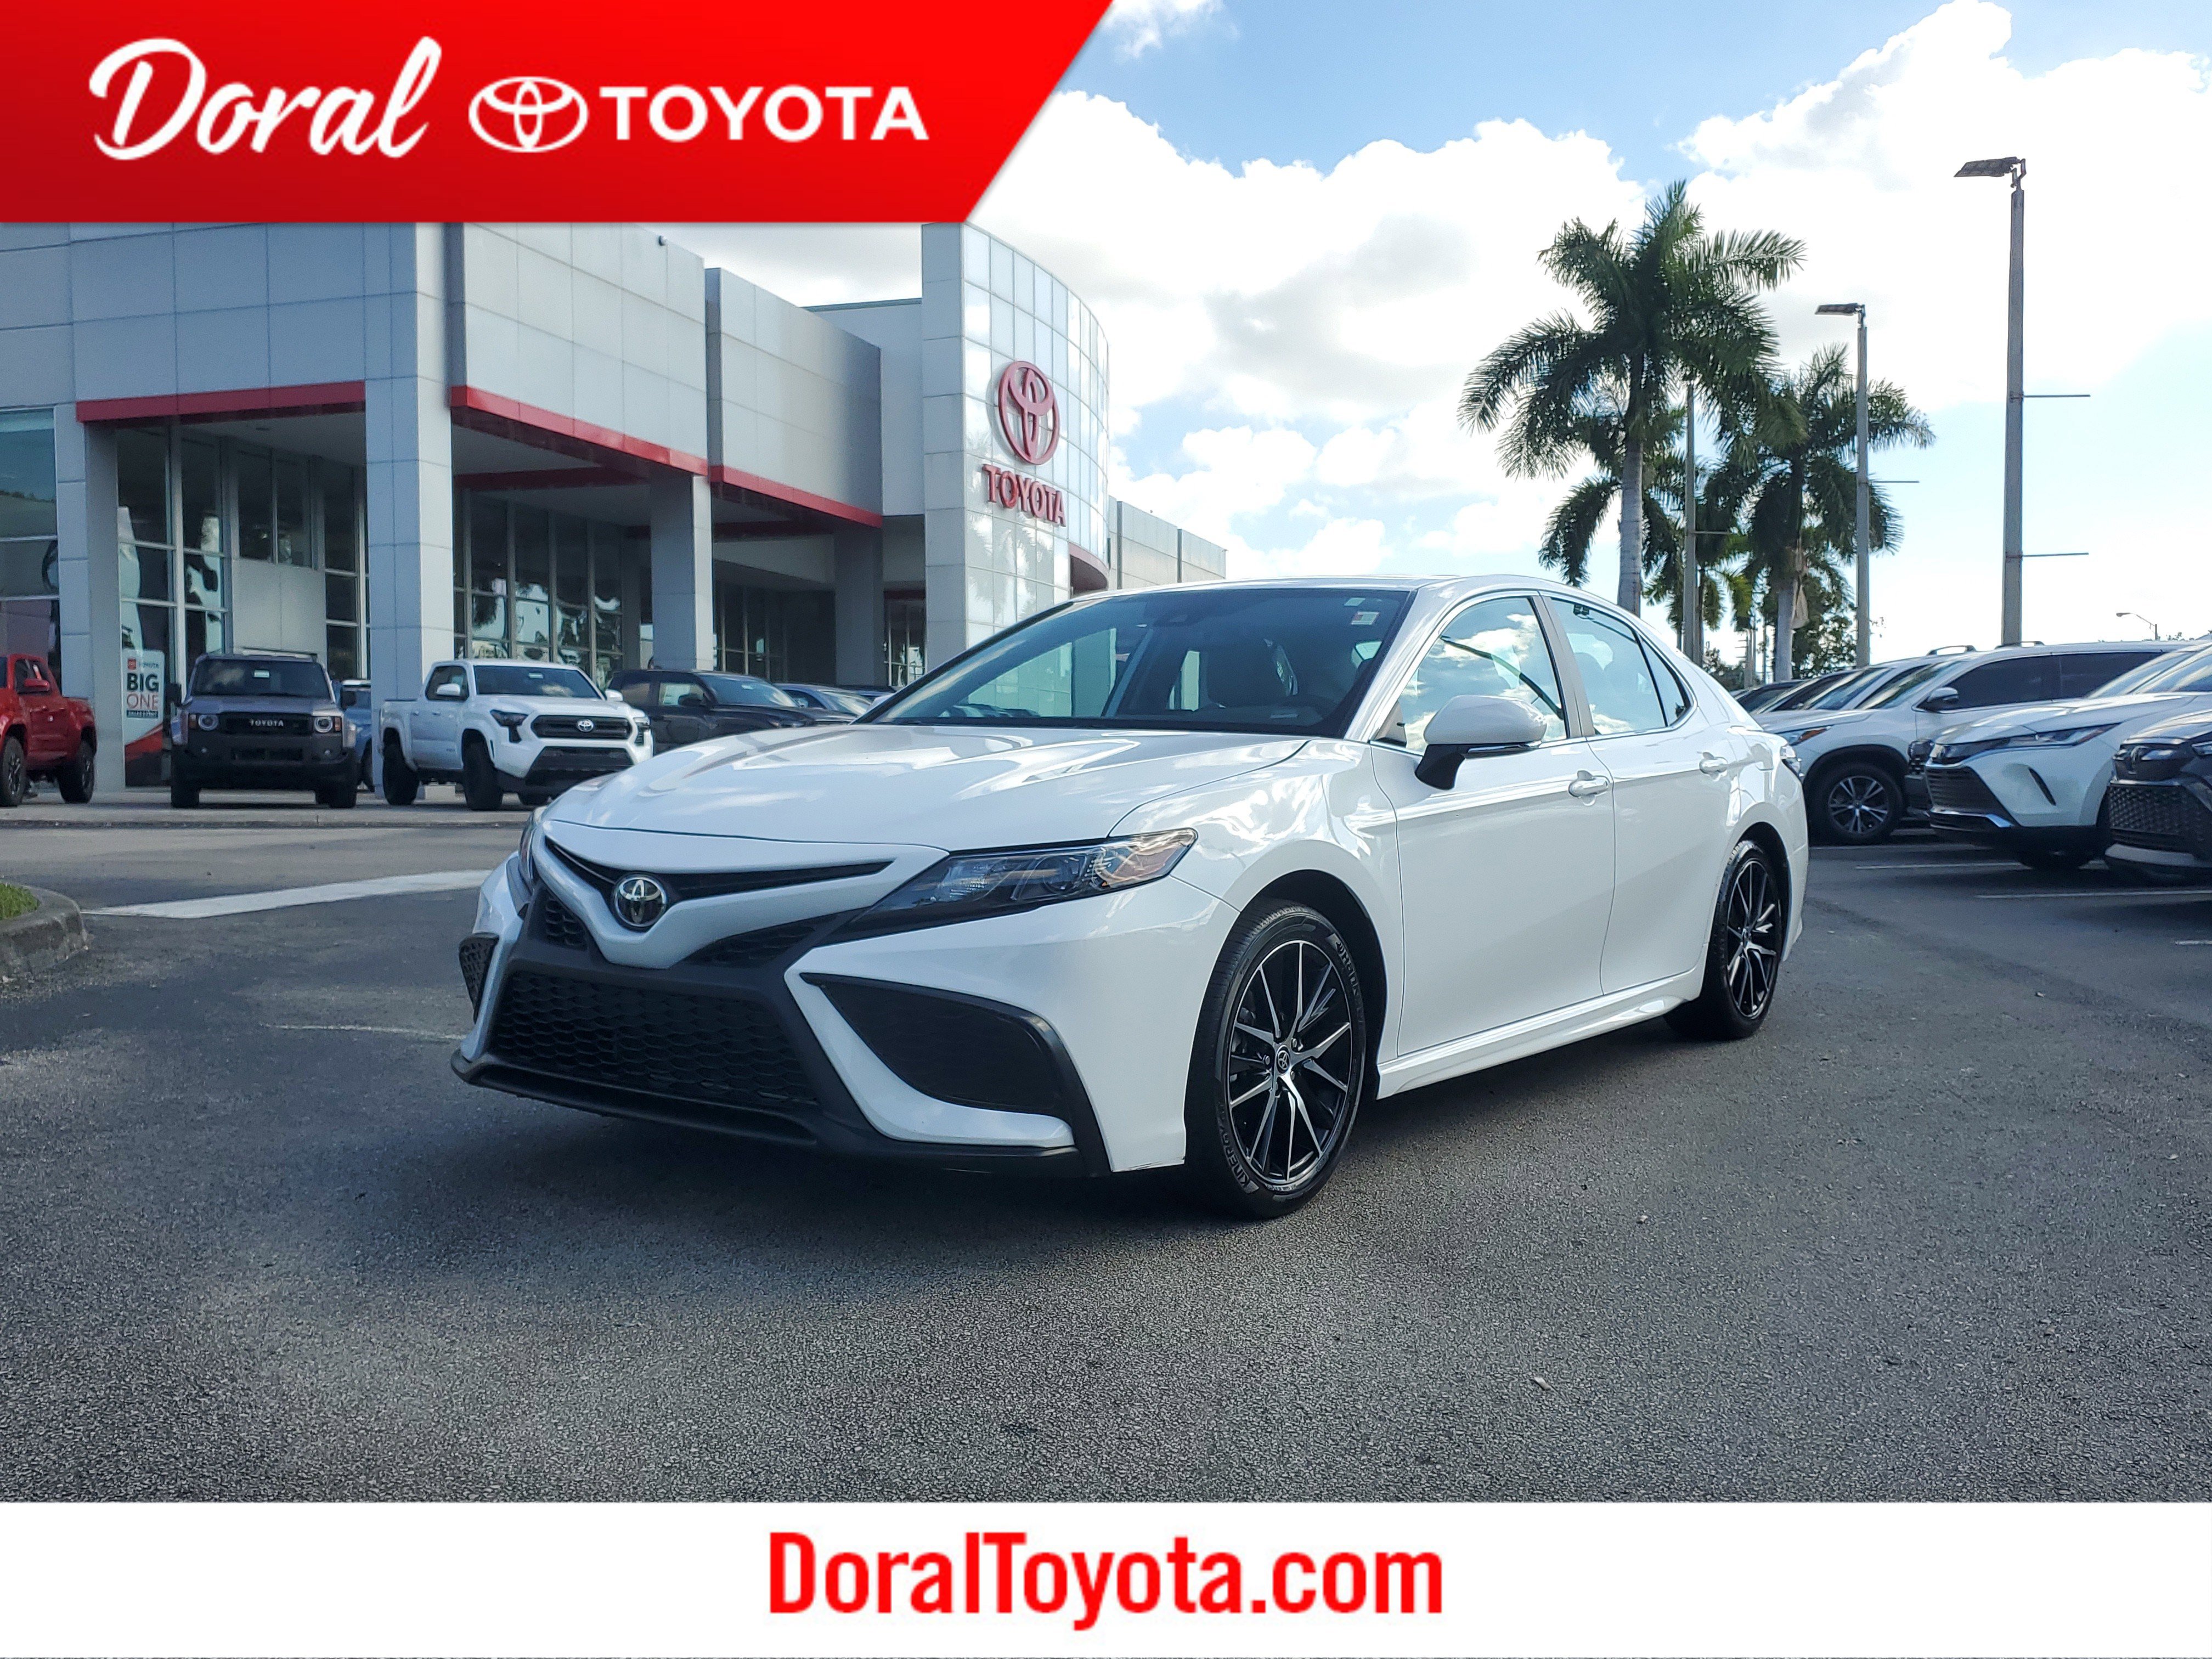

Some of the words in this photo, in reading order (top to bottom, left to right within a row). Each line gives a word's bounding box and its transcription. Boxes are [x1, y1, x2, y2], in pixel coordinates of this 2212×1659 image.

[982, 464, 1066, 527] TOYOTA
[127, 673, 159, 692] BIG
[127, 693, 159, 709] ONE
[249, 719, 284, 727] TOYOTA
